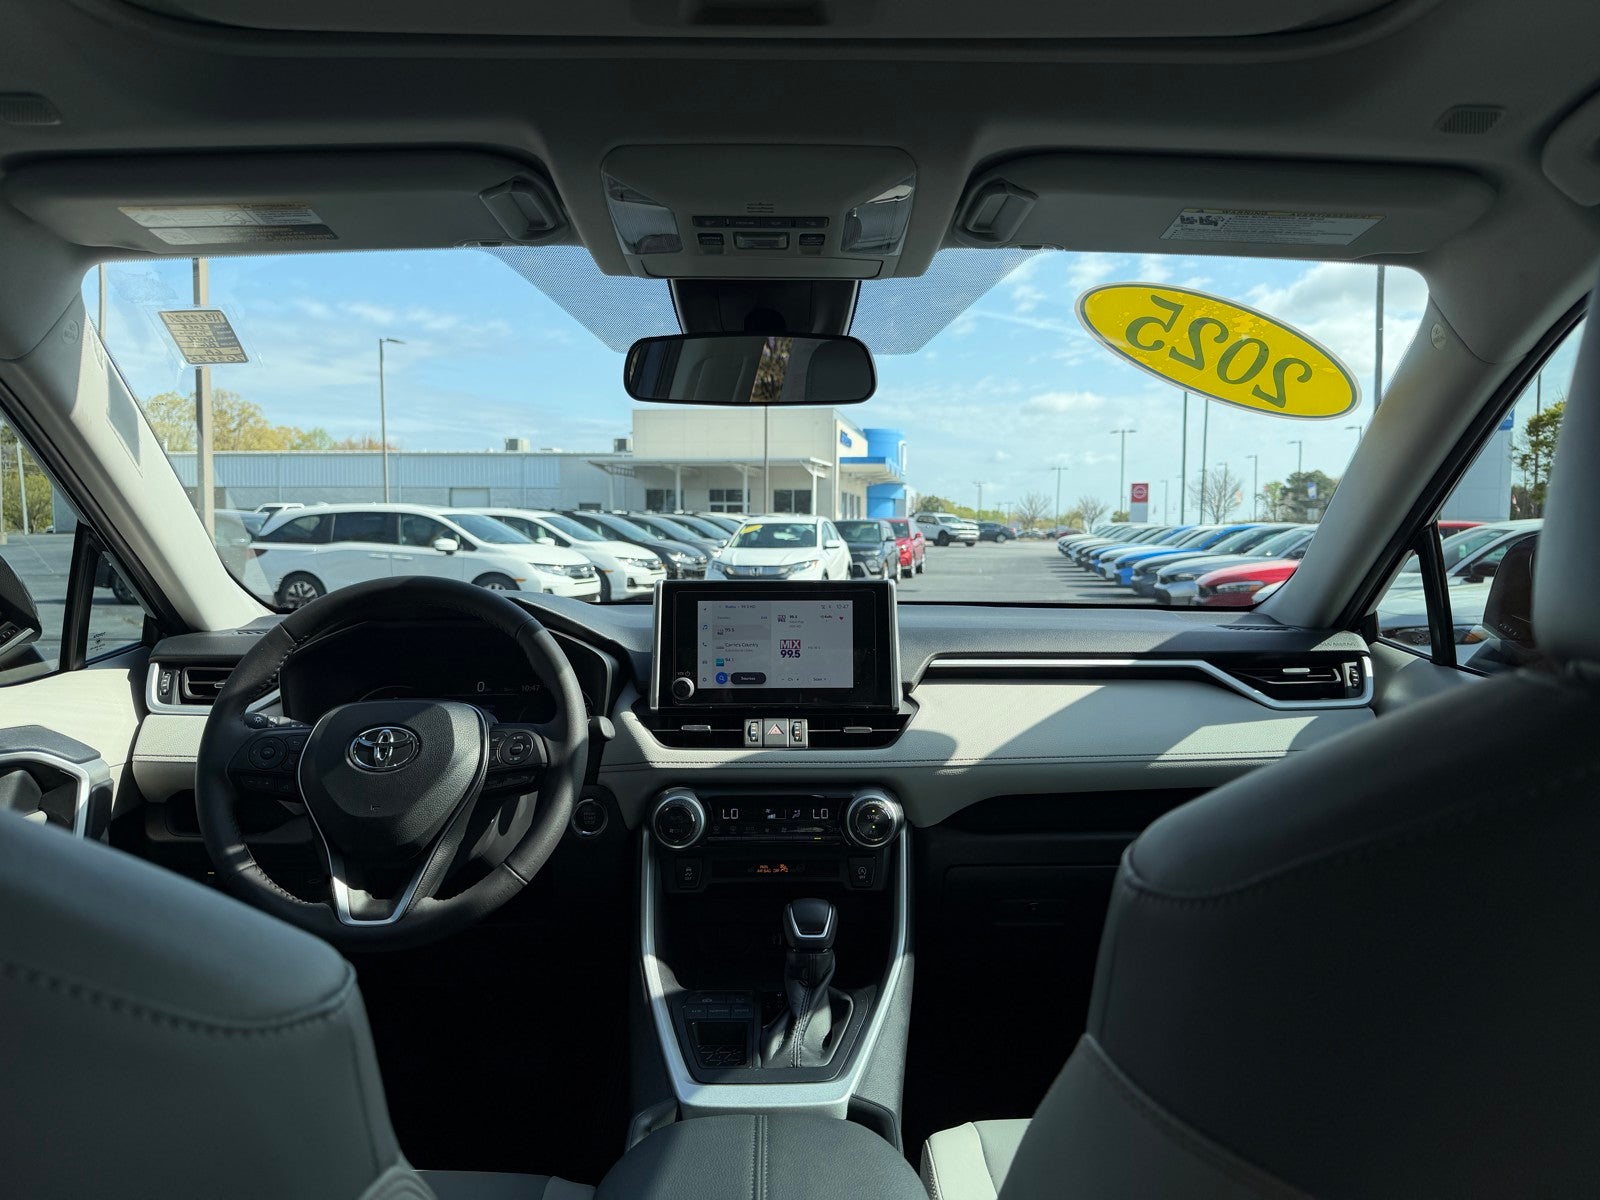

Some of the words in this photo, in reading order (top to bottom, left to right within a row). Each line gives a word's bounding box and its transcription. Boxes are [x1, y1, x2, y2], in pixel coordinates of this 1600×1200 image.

[780, 640, 801, 649] MIX
[780, 650, 801, 659] 99.5
[476, 681, 485, 693] 0
[521, 684, 541, 692] 10:47
[722, 808, 739, 820] LO
[812, 808, 829, 820] LO
